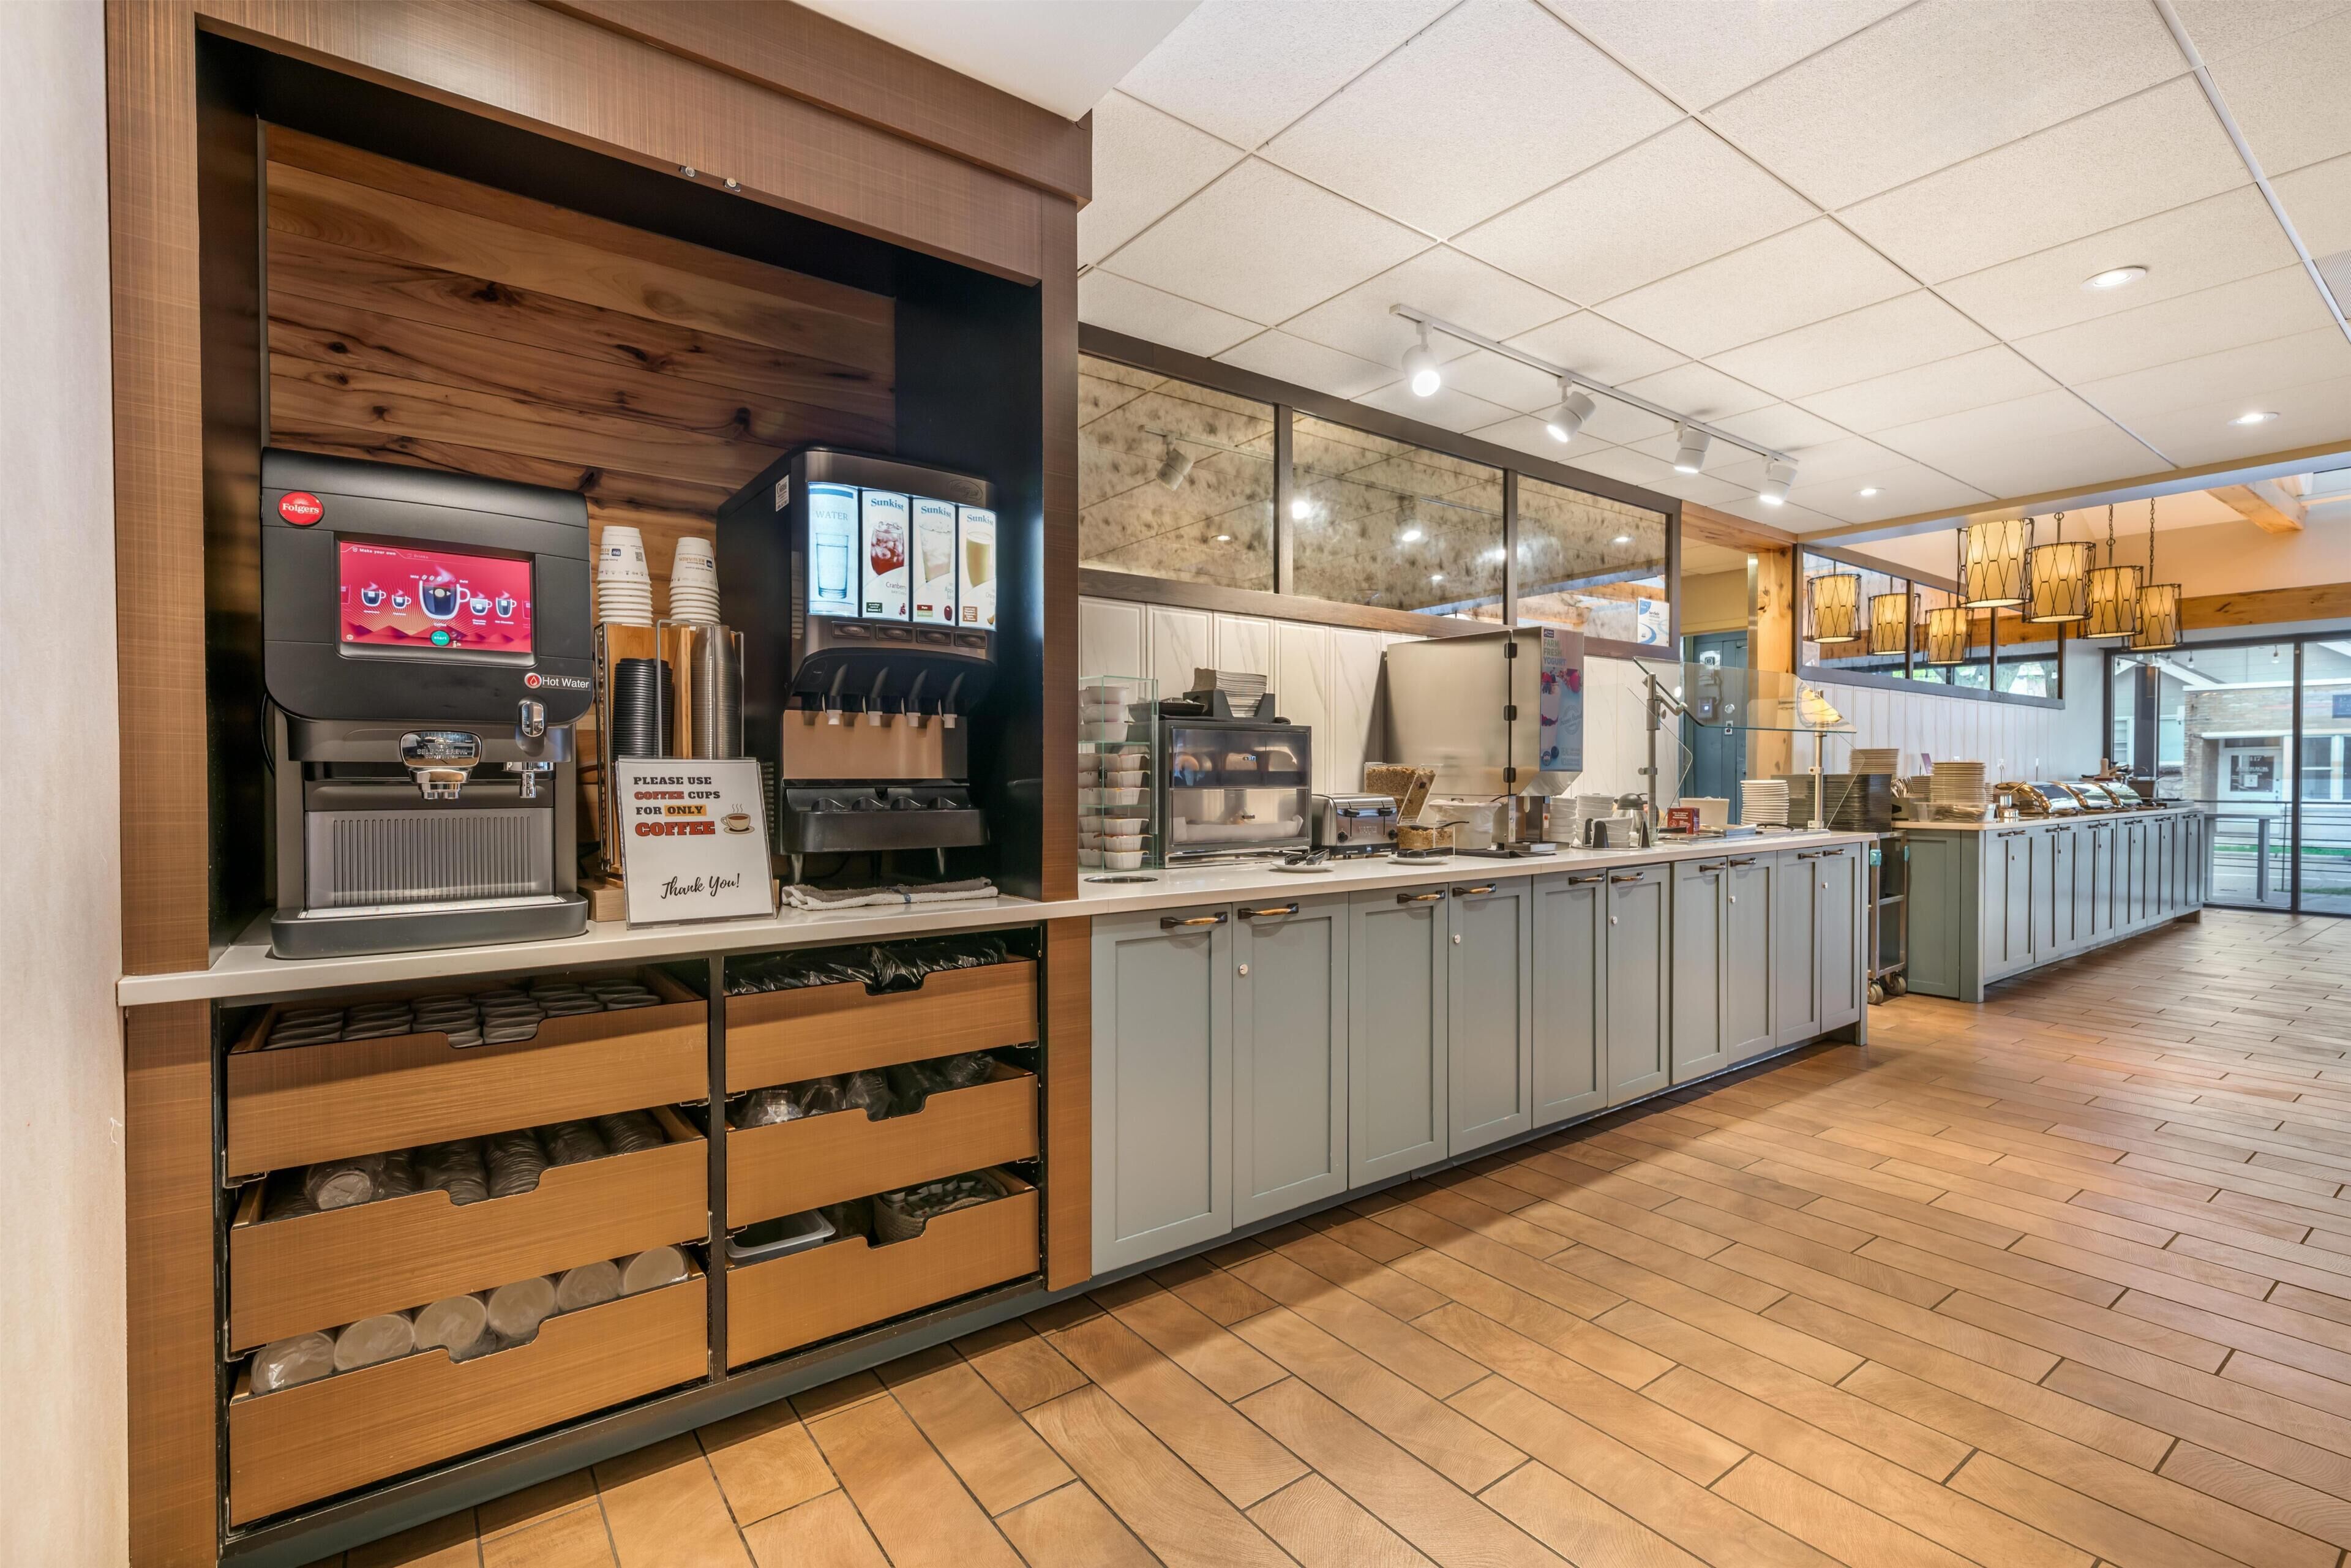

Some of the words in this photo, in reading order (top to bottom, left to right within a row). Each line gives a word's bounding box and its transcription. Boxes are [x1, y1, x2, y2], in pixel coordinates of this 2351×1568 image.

[282, 503, 319, 514] Folgers
[871, 498, 904, 512] Sunkist
[816, 510, 848, 520] WATER
[921, 506, 951, 519] Sunkist
[1543, 639, 1560, 648] FARM
[1543, 648, 1562, 657] FRESH
[1543, 656, 1567, 666] YOGURT
[542, 676, 559, 686] Hot
[561, 678, 590, 688] Water
[633, 776, 684, 785] PLEASE
[687, 776, 712, 785] USE
[634, 790, 684, 800] COFFEE
[636, 806, 662, 815] FOR
[667, 806, 703, 814] ONLY
[635, 820, 716, 837] COFFEE
[661, 876, 705, 899] Thank
[708, 872, 740, 897] You!
